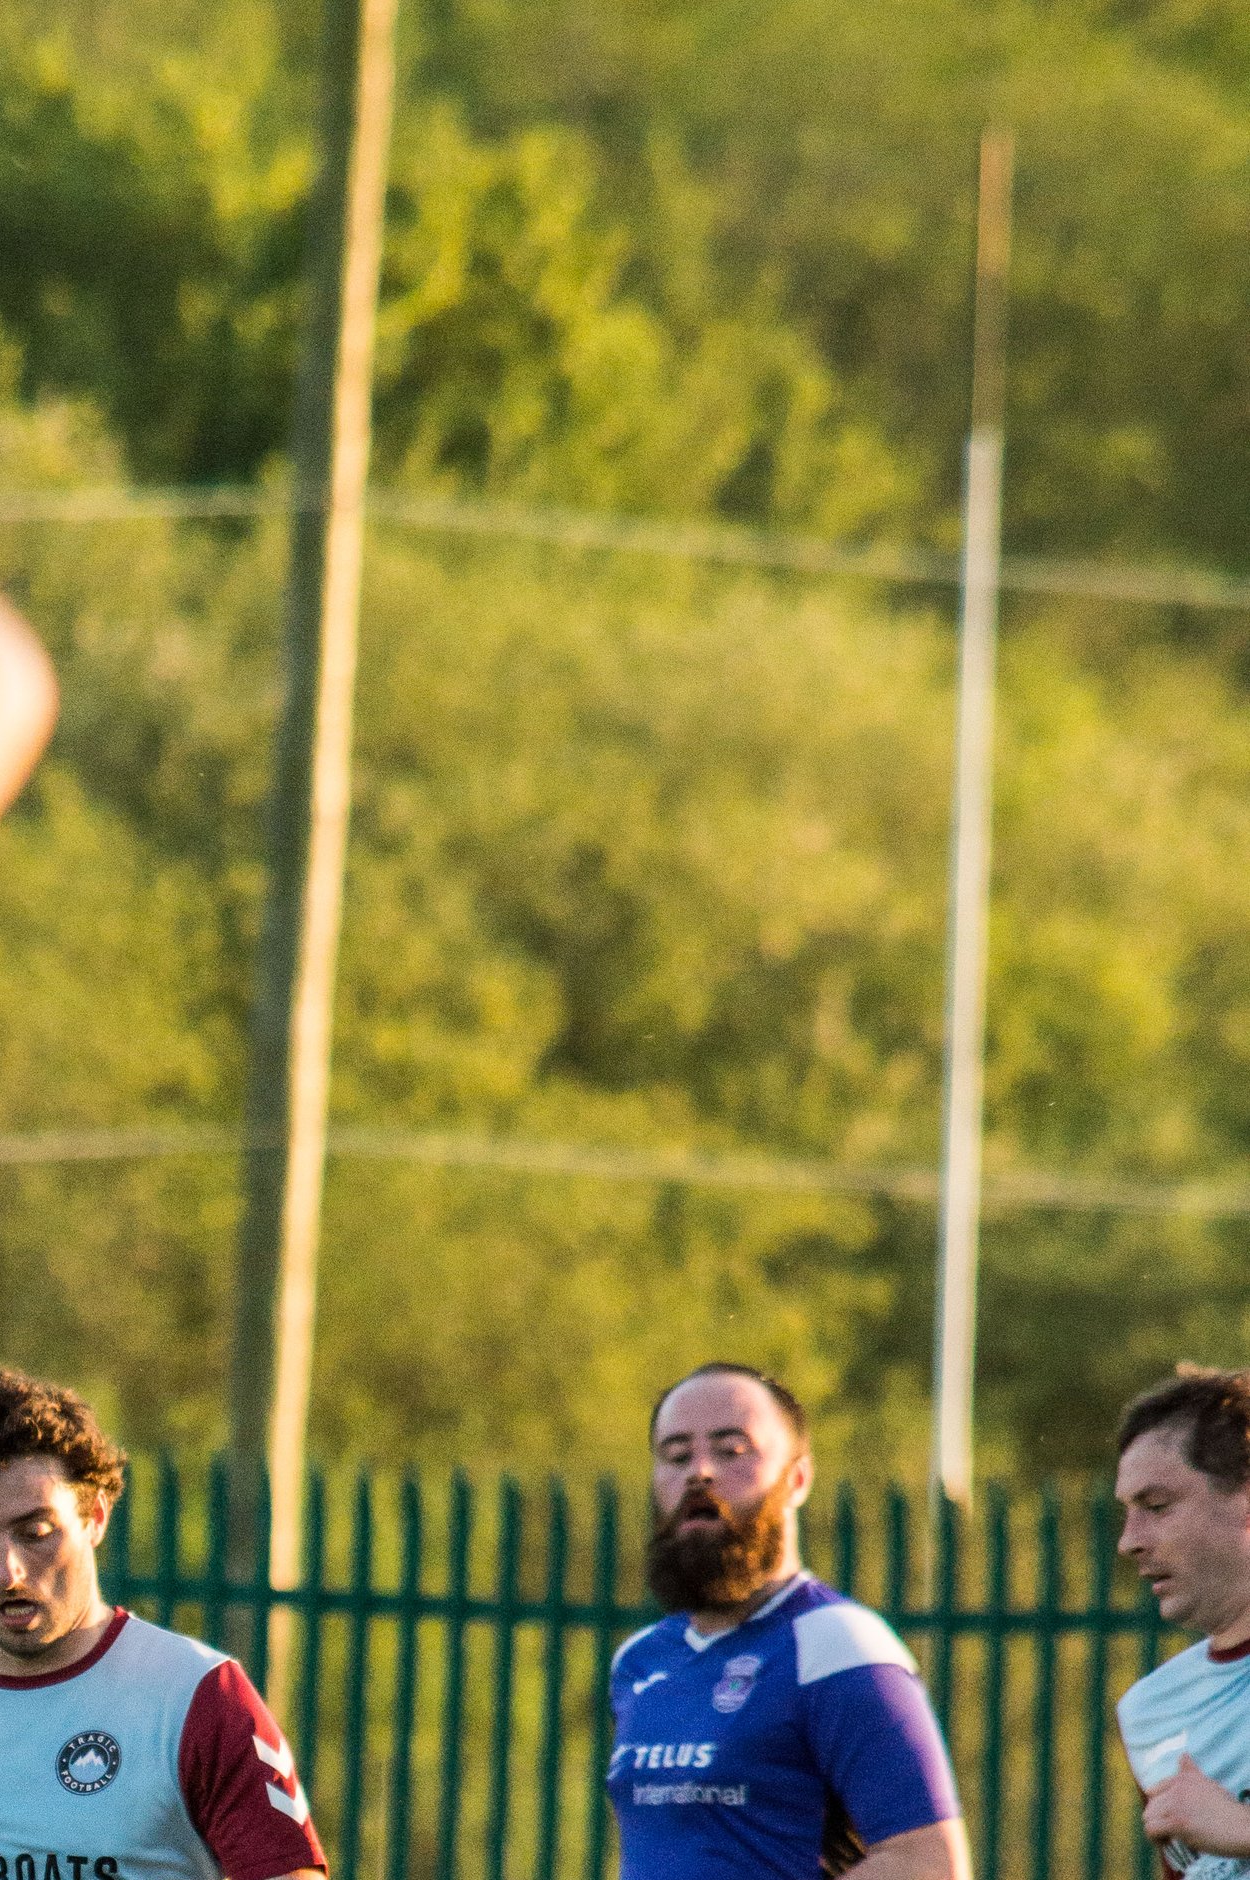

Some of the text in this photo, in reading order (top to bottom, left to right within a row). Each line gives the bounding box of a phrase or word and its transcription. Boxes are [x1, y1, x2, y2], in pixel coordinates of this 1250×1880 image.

[68, 1735, 116, 1753] TRAGIC
[633, 1743, 715, 1769] TELUS
[61, 1770, 112, 1791] FOOTBALL
